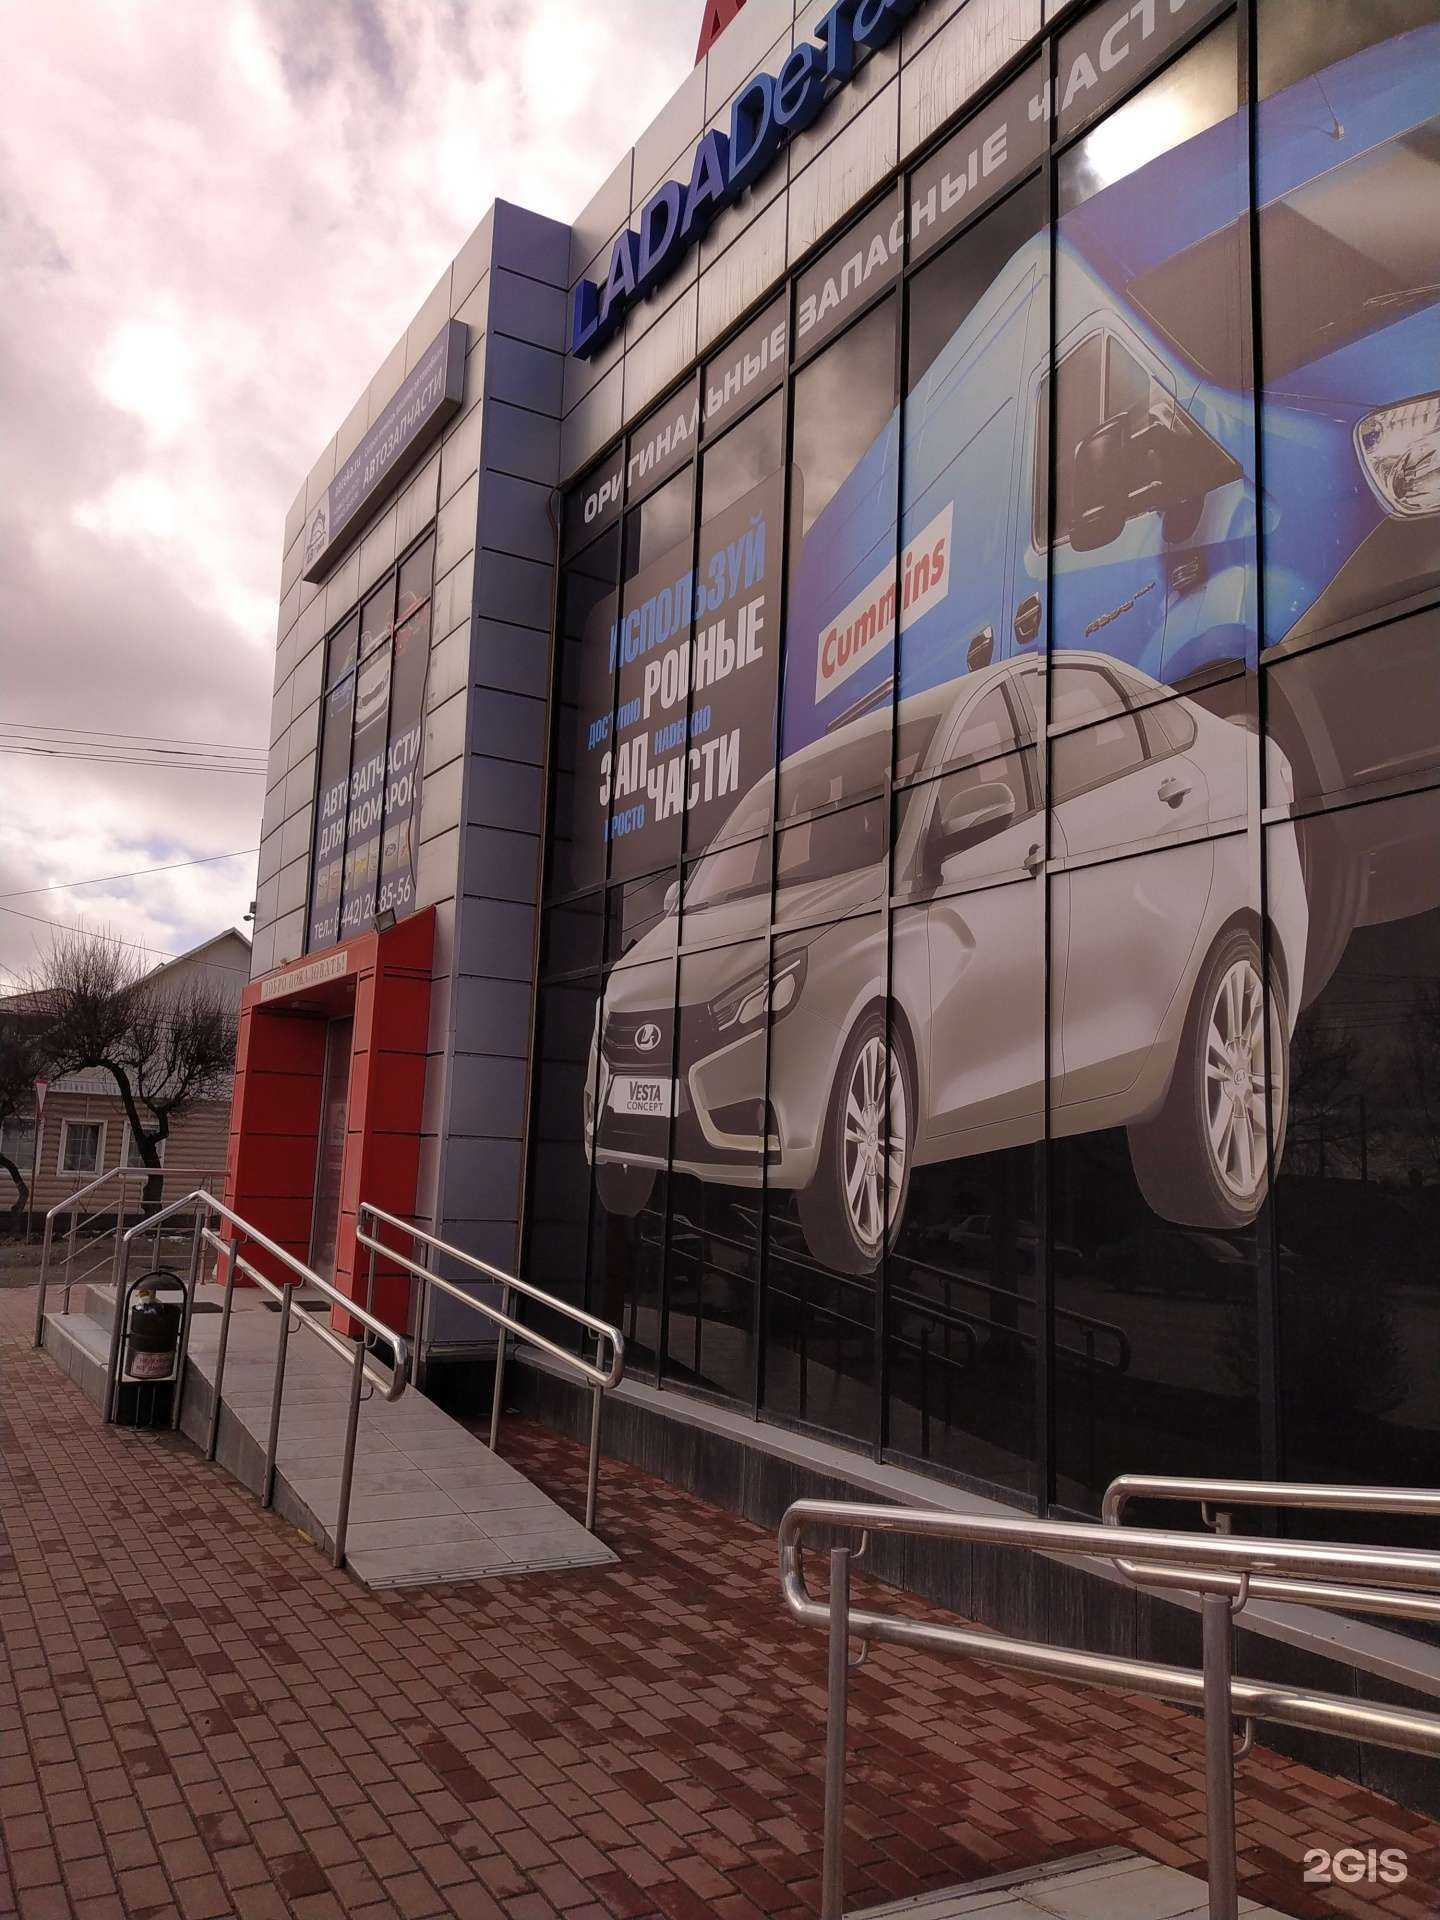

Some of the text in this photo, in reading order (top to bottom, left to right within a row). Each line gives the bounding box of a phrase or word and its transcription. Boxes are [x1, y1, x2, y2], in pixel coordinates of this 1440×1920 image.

[584, 319, 787, 524] ОРИГИНАЛЬНЫЕ
[797, 121, 1009, 338] ЗАПАСНЫЕ
[1027, 0, 1186, 122] ЧАСТ
[362, 366, 444, 489] АВТОЗАПЧАСТИ
[821, 537, 946, 679] Cummins
[599, 731, 649, 807] ЗАП
[647, 728, 741, 823] ЧАСТИ
[319, 817, 344, 861] ДЛЯ
[626, 1101, 664, 1112] CONCEPT
[629, 1080, 662, 1101] VESTA
